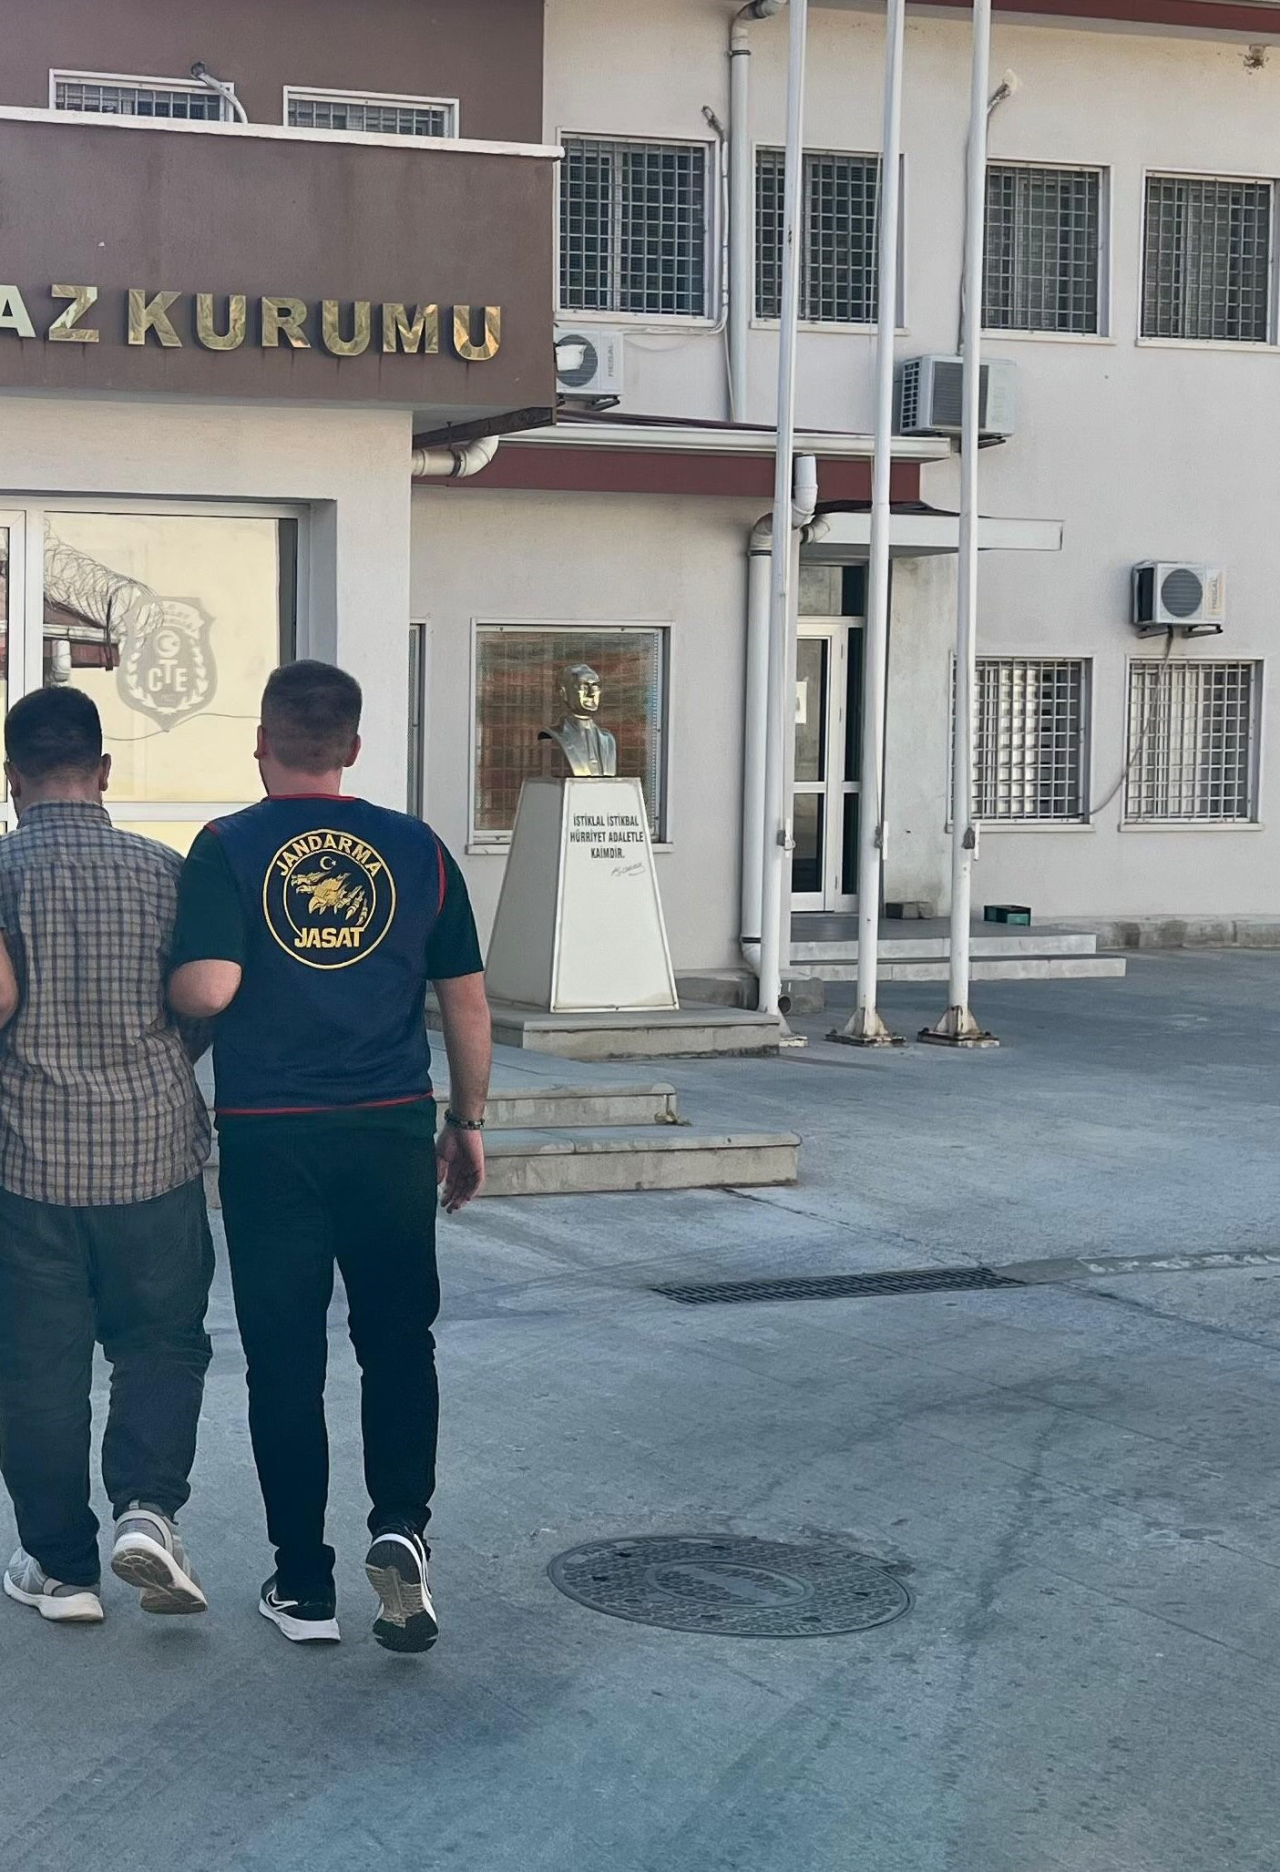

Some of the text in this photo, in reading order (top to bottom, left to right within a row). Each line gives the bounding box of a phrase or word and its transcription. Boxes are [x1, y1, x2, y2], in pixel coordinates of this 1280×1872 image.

[128, 288, 501, 361] KURUMU
[570, 829, 644, 843] HÜRRİYET ADALETLE
[276, 833, 383, 877] JANDARMA
[294, 926, 365, 949] JASAT
